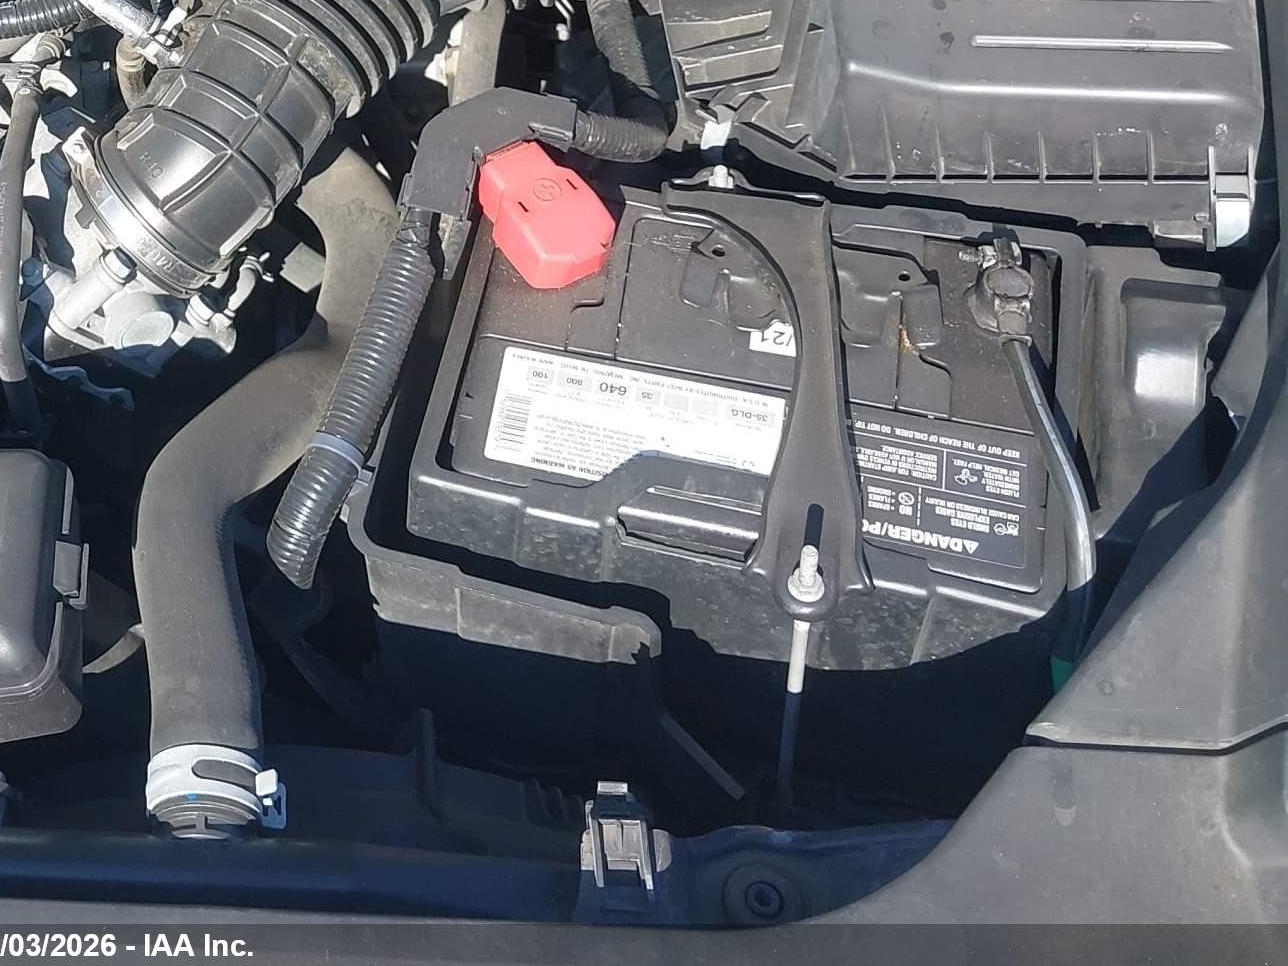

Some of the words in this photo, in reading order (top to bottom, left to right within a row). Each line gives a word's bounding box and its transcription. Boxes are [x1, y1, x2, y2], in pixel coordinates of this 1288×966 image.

[531, 369, 548, 379] 100
[565, 376, 583, 386] 800
[597, 380, 627, 397] 640
[640, 390, 653, 400] 35
[729, 406, 768, 424] 35-DLG
[866, 422, 880, 431] NOT
[880, 424, 891, 433] DO
[928, 434, 938, 442] OF
[938, 436, 962, 447] REACH
[961, 440, 976, 450] THE
[976, 443, 986, 452] OF
[987, 445, 1002, 454] OUT
[1001, 448, 1020, 458] KEEP
[897, 504, 913, 516] NO
